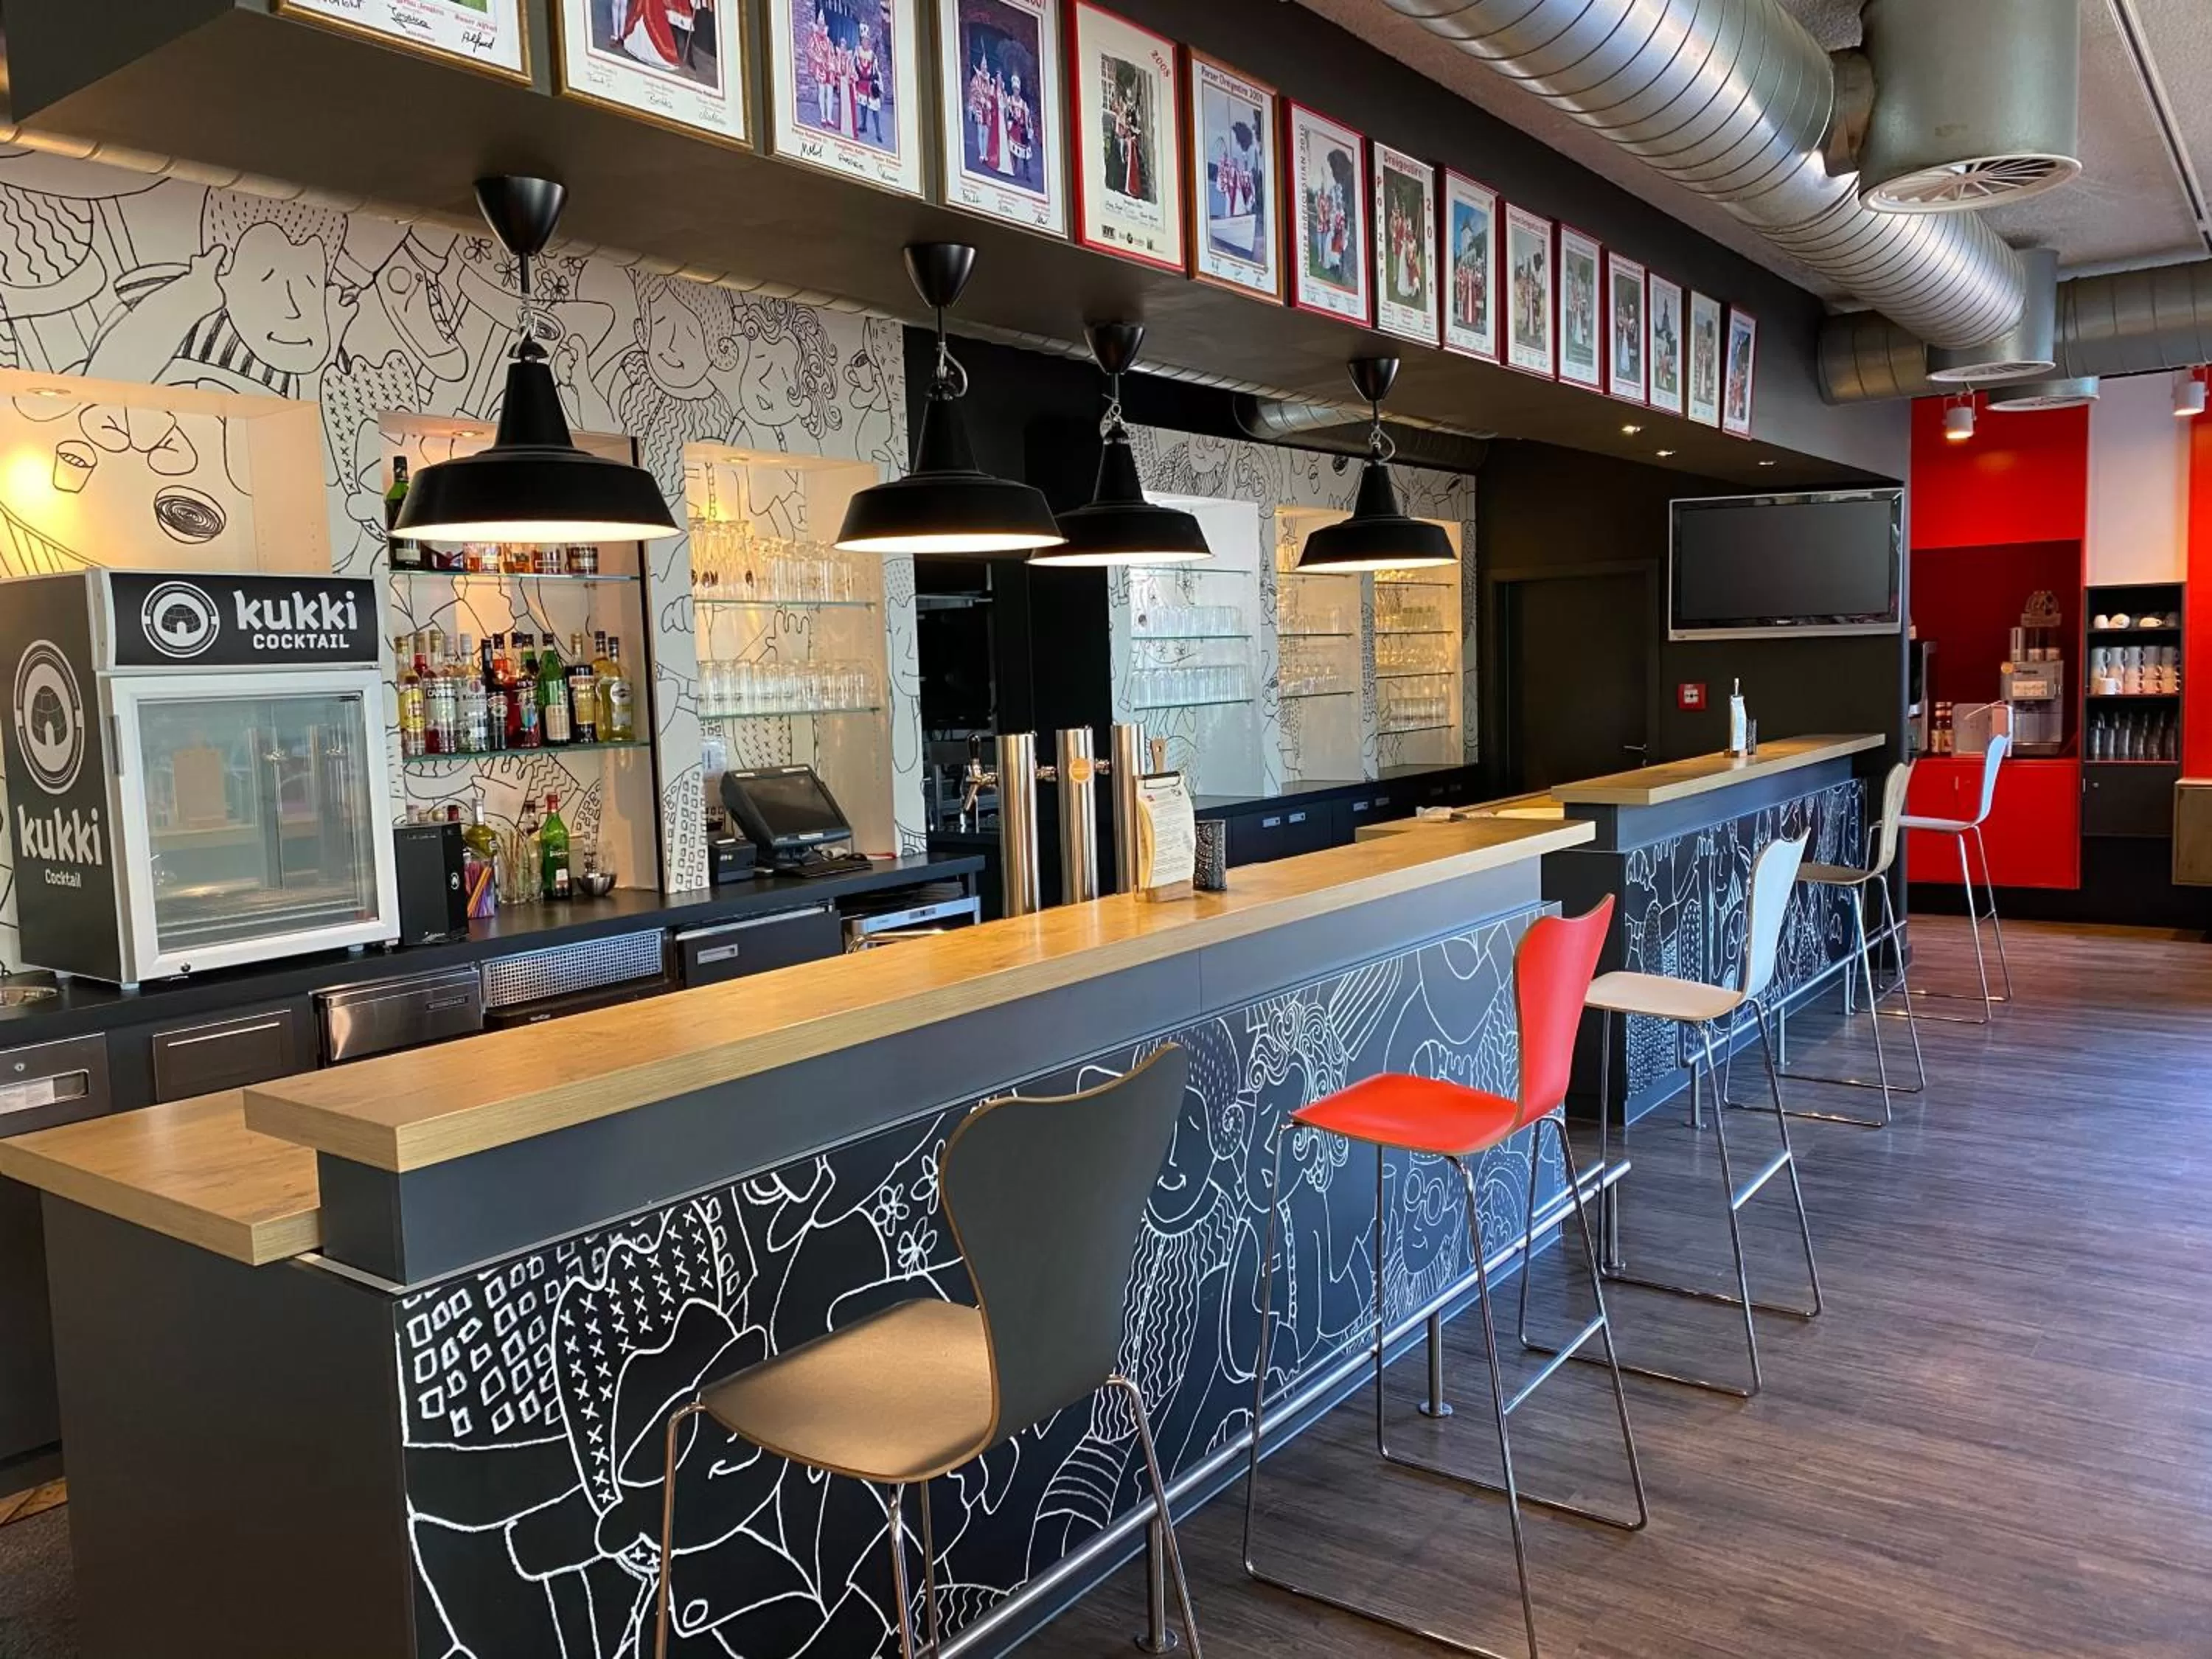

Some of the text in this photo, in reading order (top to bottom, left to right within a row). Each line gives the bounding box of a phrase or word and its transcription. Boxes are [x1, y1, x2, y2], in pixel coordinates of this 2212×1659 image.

[233, 589, 358, 630] kukki
[253, 633, 349, 649] COCKTAIL
[17, 804, 102, 866] kukki
[45, 869, 82, 888] Cocktail
